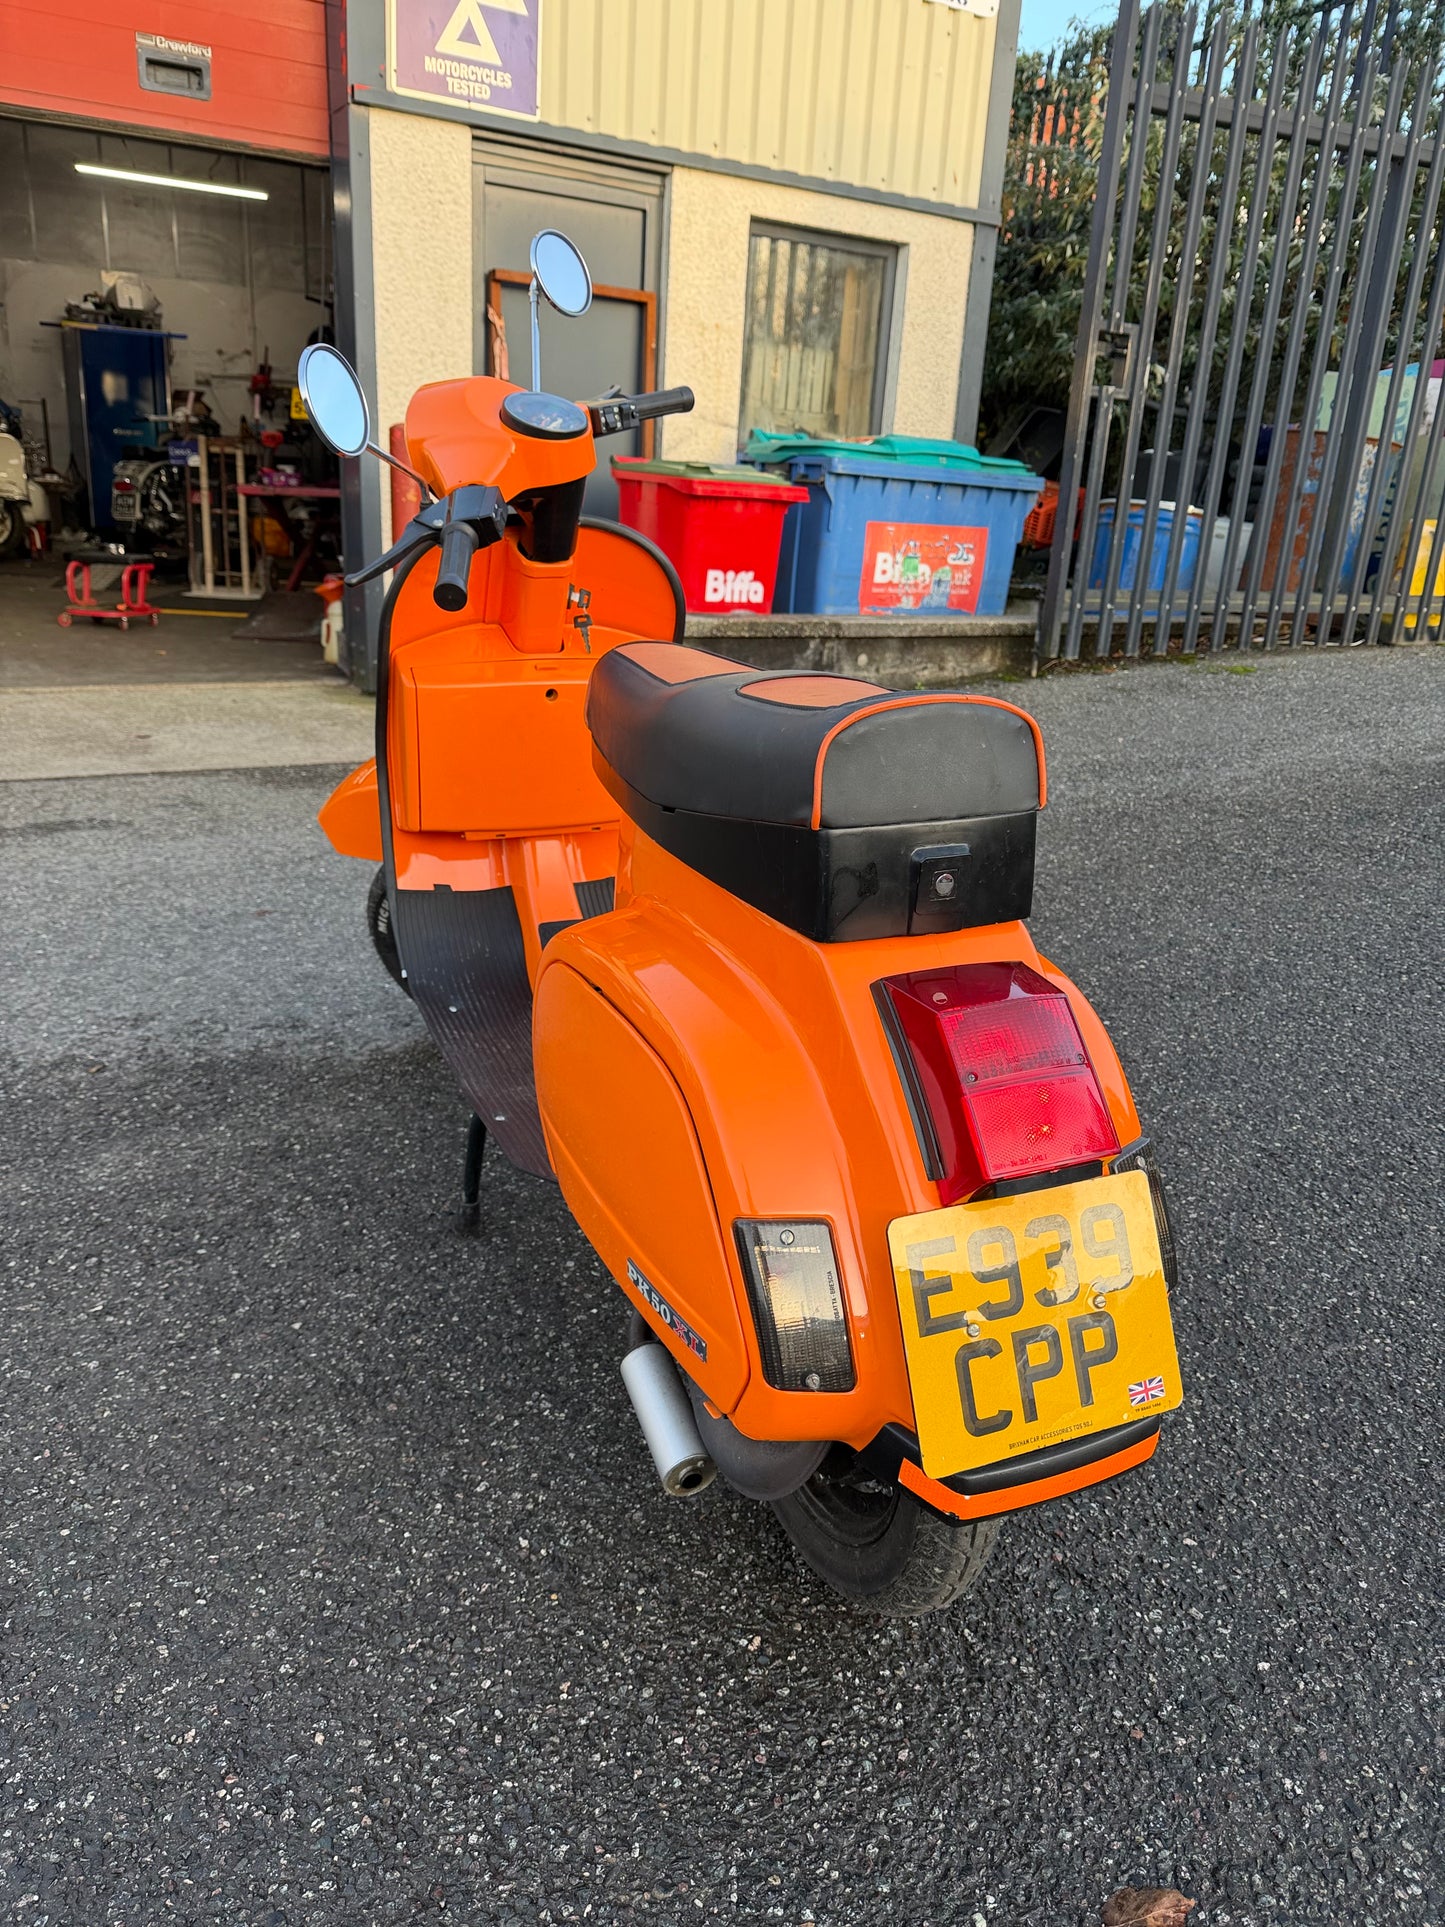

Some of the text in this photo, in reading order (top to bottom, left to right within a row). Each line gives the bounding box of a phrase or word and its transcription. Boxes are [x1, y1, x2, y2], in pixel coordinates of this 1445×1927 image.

[156, 35, 212, 57] Crawford
[424, 55, 513, 89] MOTORCYCLES
[446, 77, 491, 100] TESTED
[704, 568, 765, 604] Biffa
[905, 1203, 1134, 1338] E939
[955, 1310, 1118, 1438] CPP
[1030, 1435, 1040, 1444] CAR
[1040, 1426, 1073, 1441] ACCESSORIES
